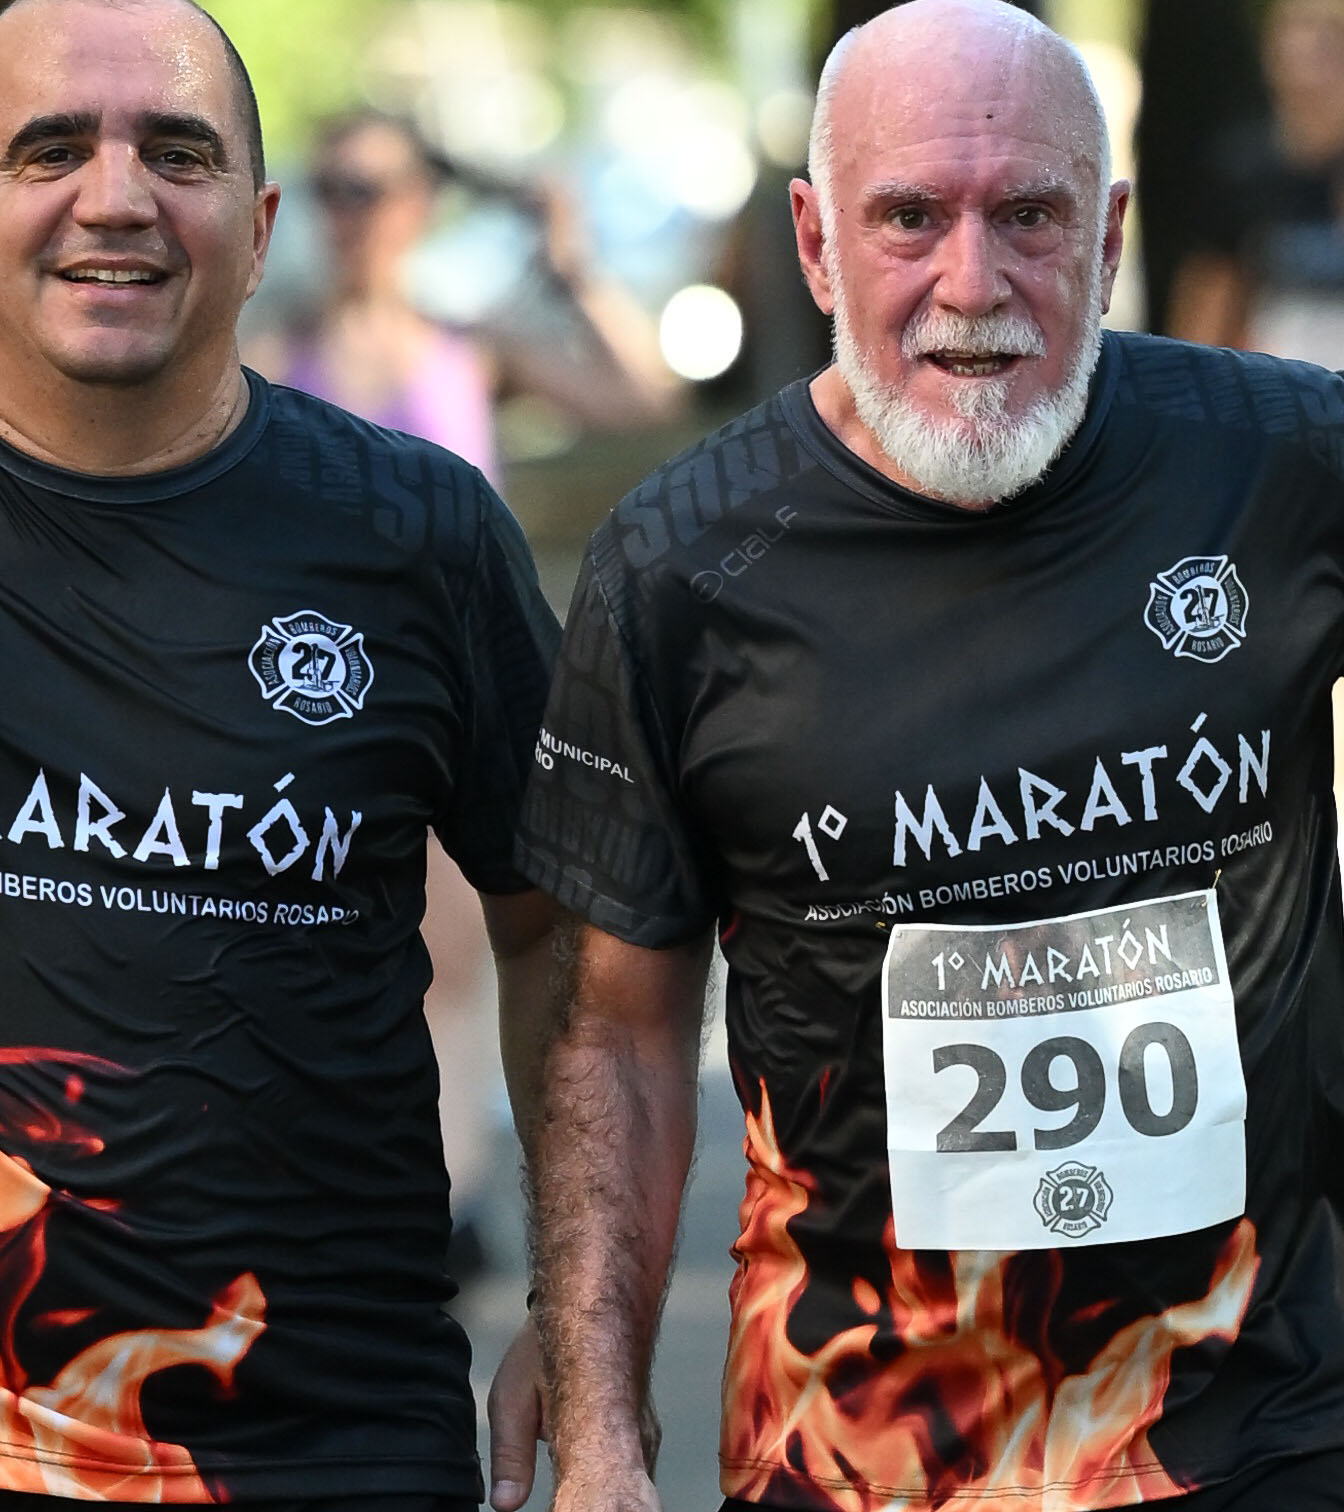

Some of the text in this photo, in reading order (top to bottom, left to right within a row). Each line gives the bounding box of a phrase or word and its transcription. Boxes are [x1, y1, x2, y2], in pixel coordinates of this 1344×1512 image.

[1179, 586, 1219, 624] 27
[292, 641, 337, 681] 27
[541, 728, 634, 784] MUNICIPAL
[893, 712, 1271, 867] MARATÓN
[918, 867, 1053, 909] BOMBEROS
[1057, 840, 1215, 885] VOLUNTARIOS
[99, 886, 269, 925] VOLUNTARIOS
[980, 918, 1172, 991] MARATÓN
[900, 966, 1213, 1017] ASOCIACIÓN BOMBEROS VOLUNTARIOS ROSARIO
[932, 1021, 1199, 1154] 290
[1059, 1185, 1089, 1211] 27
